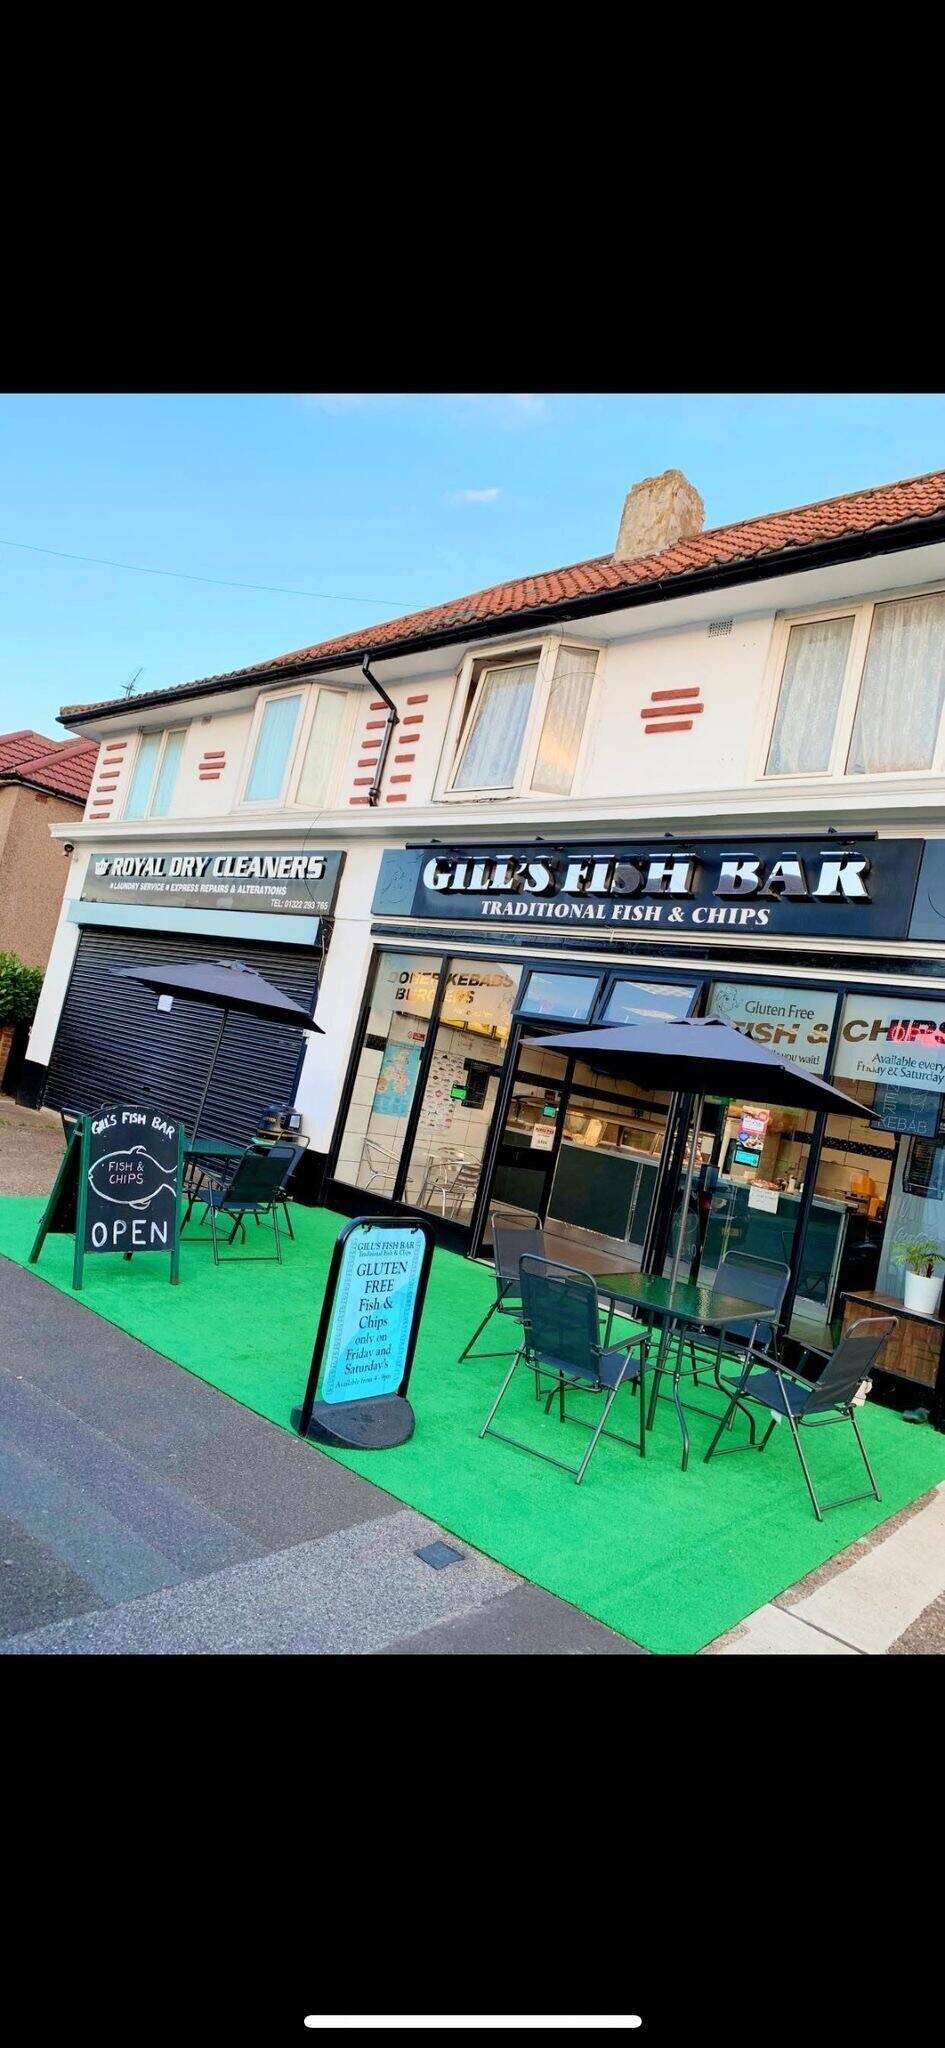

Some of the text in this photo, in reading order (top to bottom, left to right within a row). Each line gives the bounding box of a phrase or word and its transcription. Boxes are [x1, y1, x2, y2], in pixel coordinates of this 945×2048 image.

[111, 856, 325, 880] ROYAL DRY CLEANERS
[422, 851, 868, 898] GILL'S FISH BAR
[113, 882, 165, 892] LAUNDRY SERVICE
[170, 884, 287, 895] EXPRESS REPAIRS & ALTERATIONS
[271, 899, 284, 908] TEL:
[481, 900, 771, 926] TRADITIONAL FISH & CHIPS
[745, 1000, 815, 1020] Gluten Free
[806, 1023, 829, 1044] &
[799, 1055, 821, 1065] wait!
[872, 1053, 945, 1074] Available every
[857, 1061, 945, 1085] Friday & Saturday
[91, 1112, 175, 1139] GILL'S FISH BAR
[108, 1161, 144, 1172] FISH &
[109, 1173, 144, 1185] CHIPS
[91, 1219, 168, 1248] OPEN
[357, 1241, 415, 1251] GILL'S FISH BAR
[357, 1262, 408, 1277] GLUTEN
[364, 1279, 394, 1294] FREE
[359, 1296, 393, 1311] Fish &
[359, 1315, 388, 1330] Chips
[354, 1332, 387, 1345] only on
[346, 1344, 391, 1361] Friday and
[344, 1359, 389, 1375] Saturday's
